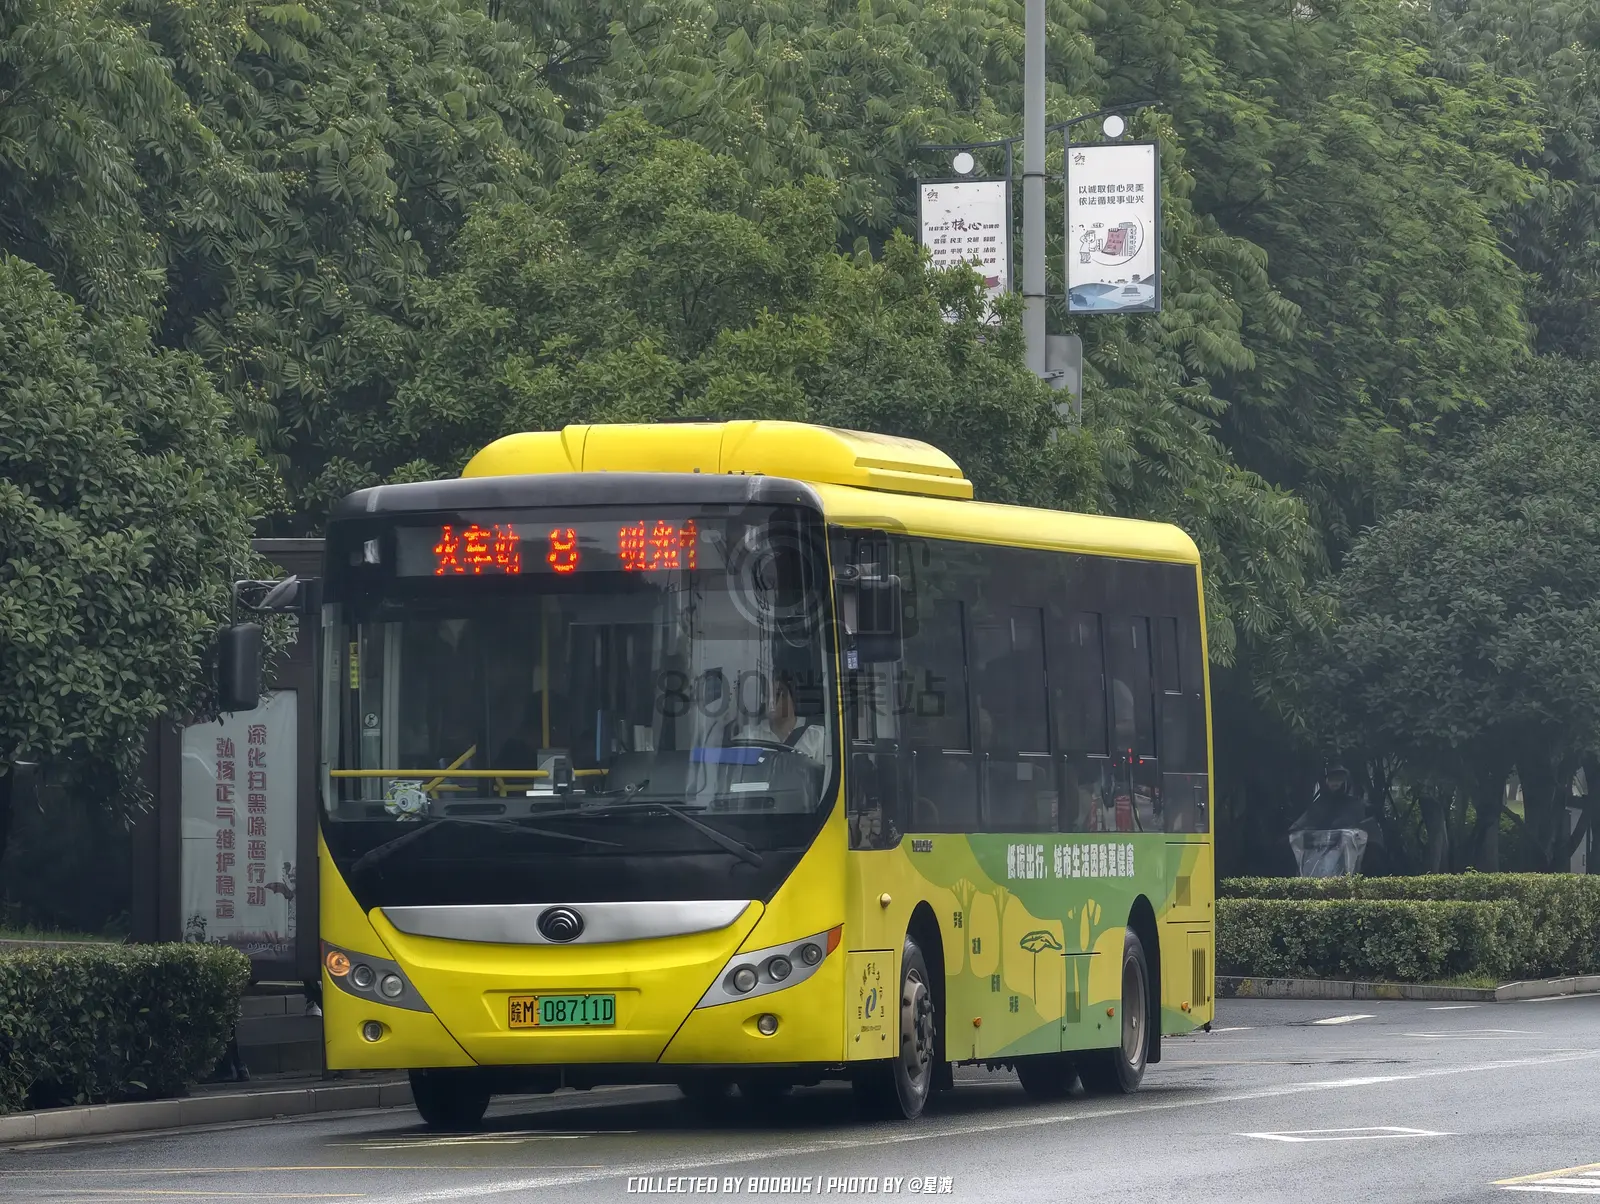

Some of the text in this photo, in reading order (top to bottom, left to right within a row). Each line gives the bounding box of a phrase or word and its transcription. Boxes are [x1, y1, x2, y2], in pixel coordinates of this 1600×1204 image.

[1078, 183, 1145, 195] 以诚取信心灵美
[1078, 194, 1145, 206] 依法循规事业兴
[547, 527, 579, 574] 8
[215, 736, 236, 919] 弘扬正气维护稳定
[246, 723, 268, 907] 深化扫黑除恶行动
